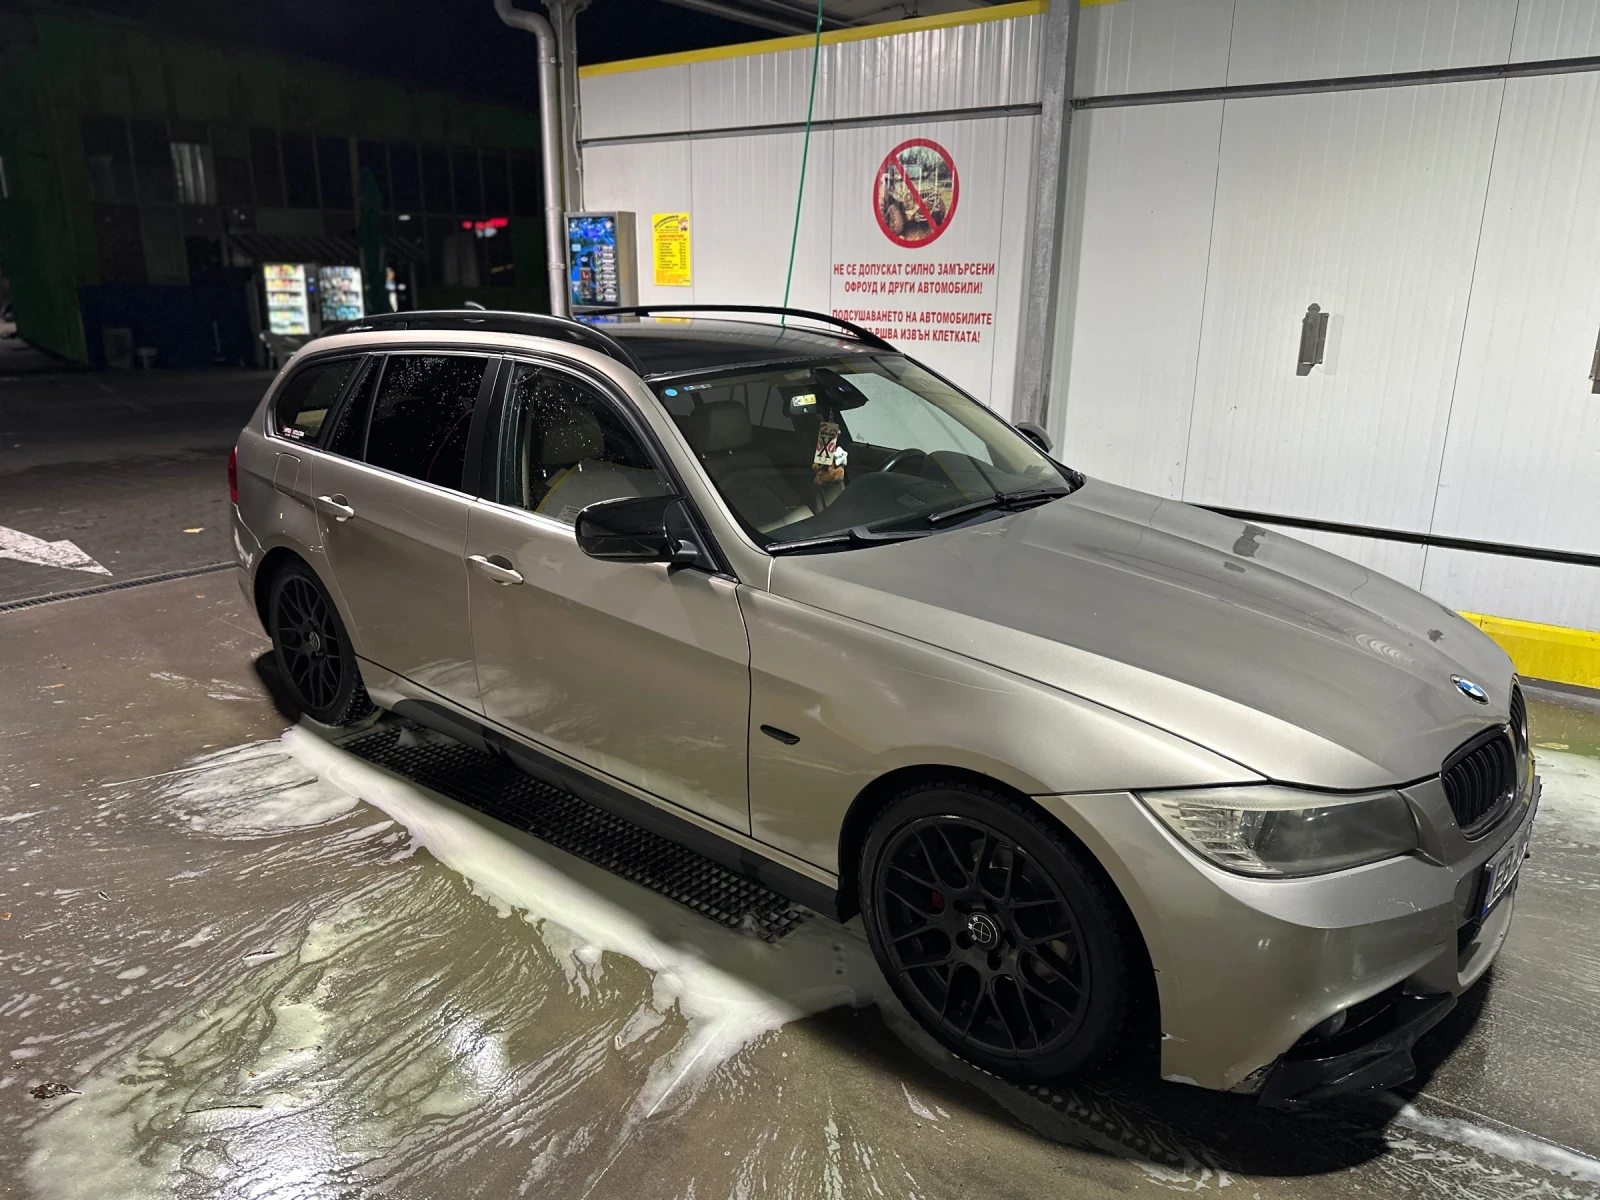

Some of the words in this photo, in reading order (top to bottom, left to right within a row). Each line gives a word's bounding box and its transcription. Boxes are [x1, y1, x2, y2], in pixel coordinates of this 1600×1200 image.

[833, 264, 845, 276] НЕ
[846, 264, 857, 276] СЕ
[858, 263, 903, 278] ДОПУСКАТ
[904, 263, 935, 276] СИЛНО
[937, 263, 995, 276] ЗАМЪРСЕНИ
[844, 281, 878, 295] ОФРОУД
[880, 281, 886, 293] И
[888, 281, 915, 295] ДРУГИ
[917, 281, 983, 295] АВТОМОБИЛИ!
[832, 309, 903, 323] ПОДСУШАВАНЕТО
[905, 311, 917, 323] НА
[919, 312, 993, 326] АВТОМОБИЛИТЕ
[900, 328, 930, 341] ИЗВЪН
[932, 330, 981, 343] КЛЕТКАТА!
